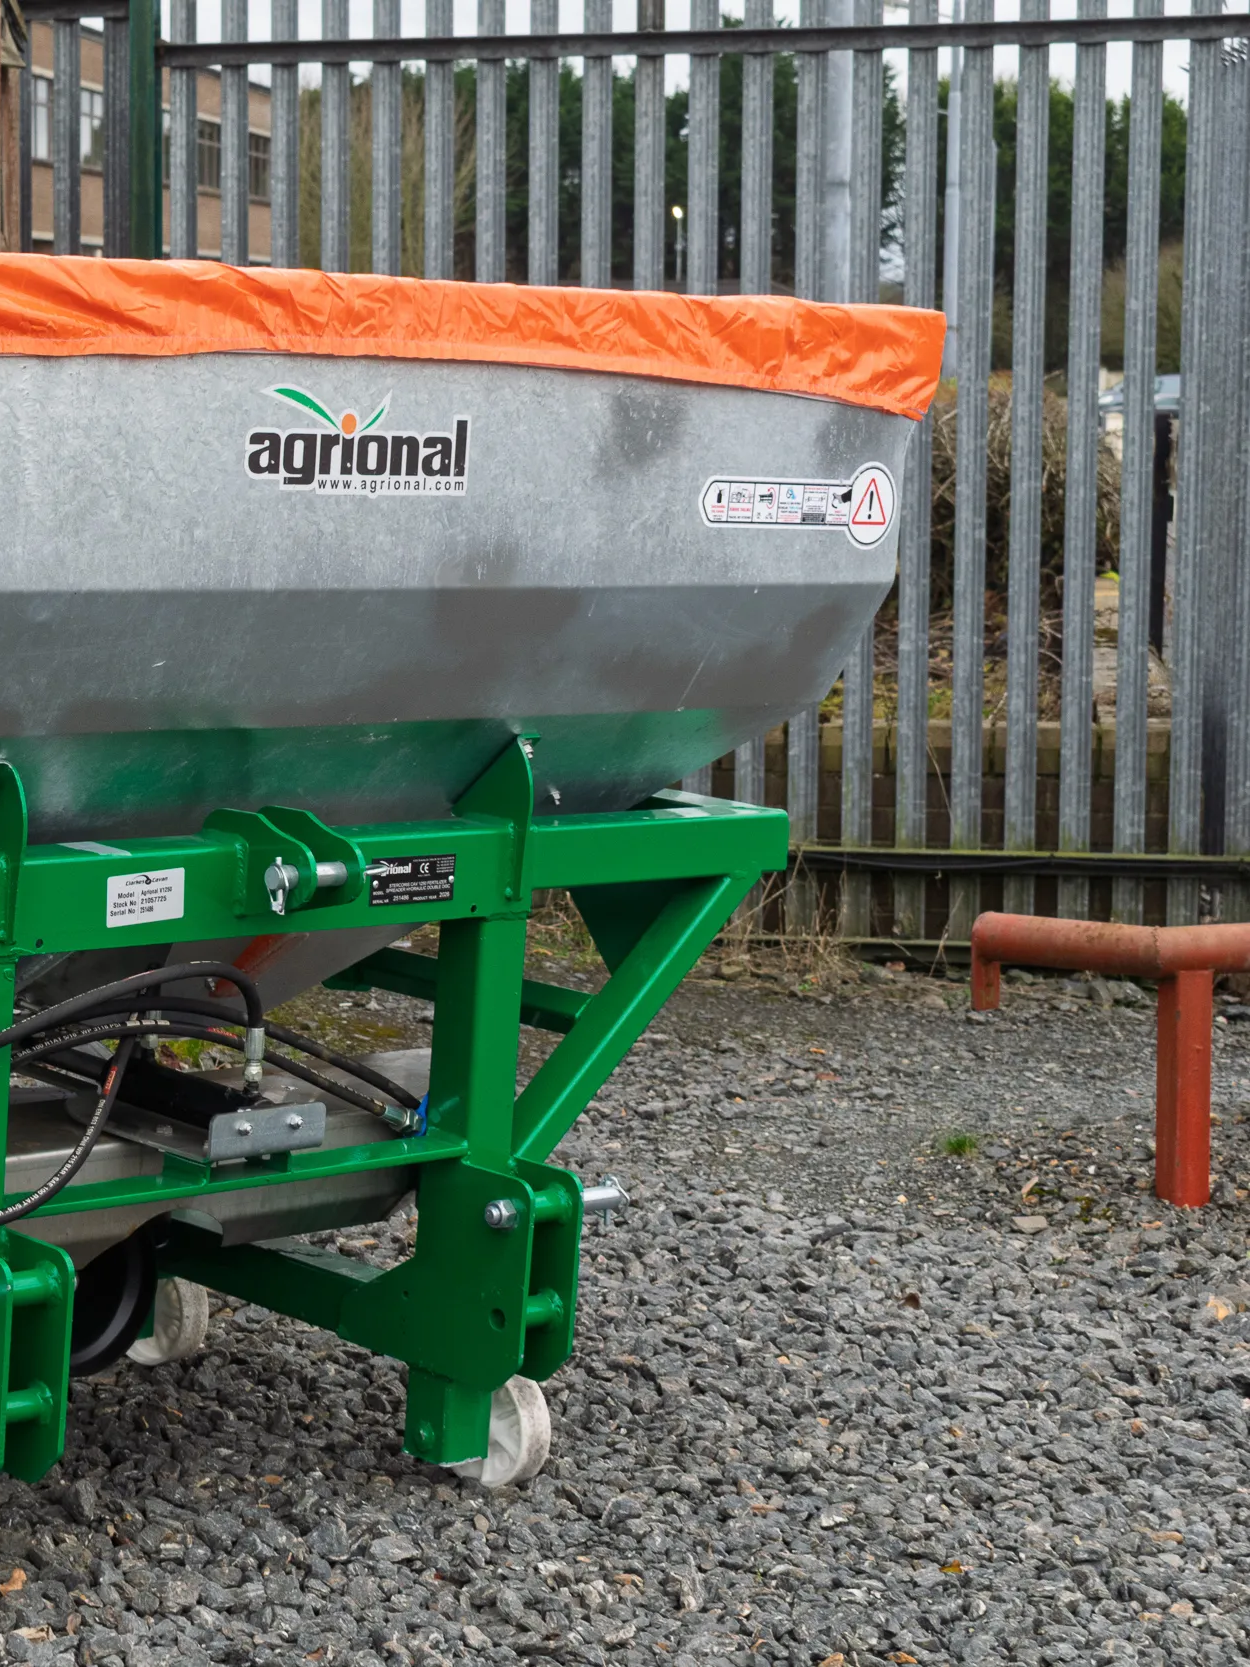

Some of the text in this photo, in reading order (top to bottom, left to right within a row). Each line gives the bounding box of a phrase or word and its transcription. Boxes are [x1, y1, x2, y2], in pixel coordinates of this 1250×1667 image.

[248, 417, 468, 485] agrional
[317, 477, 465, 493] www.agrional.com
[118, 891, 135, 899] Model
[113, 900, 127, 909] Stock
[110, 908, 126, 917] Serial
